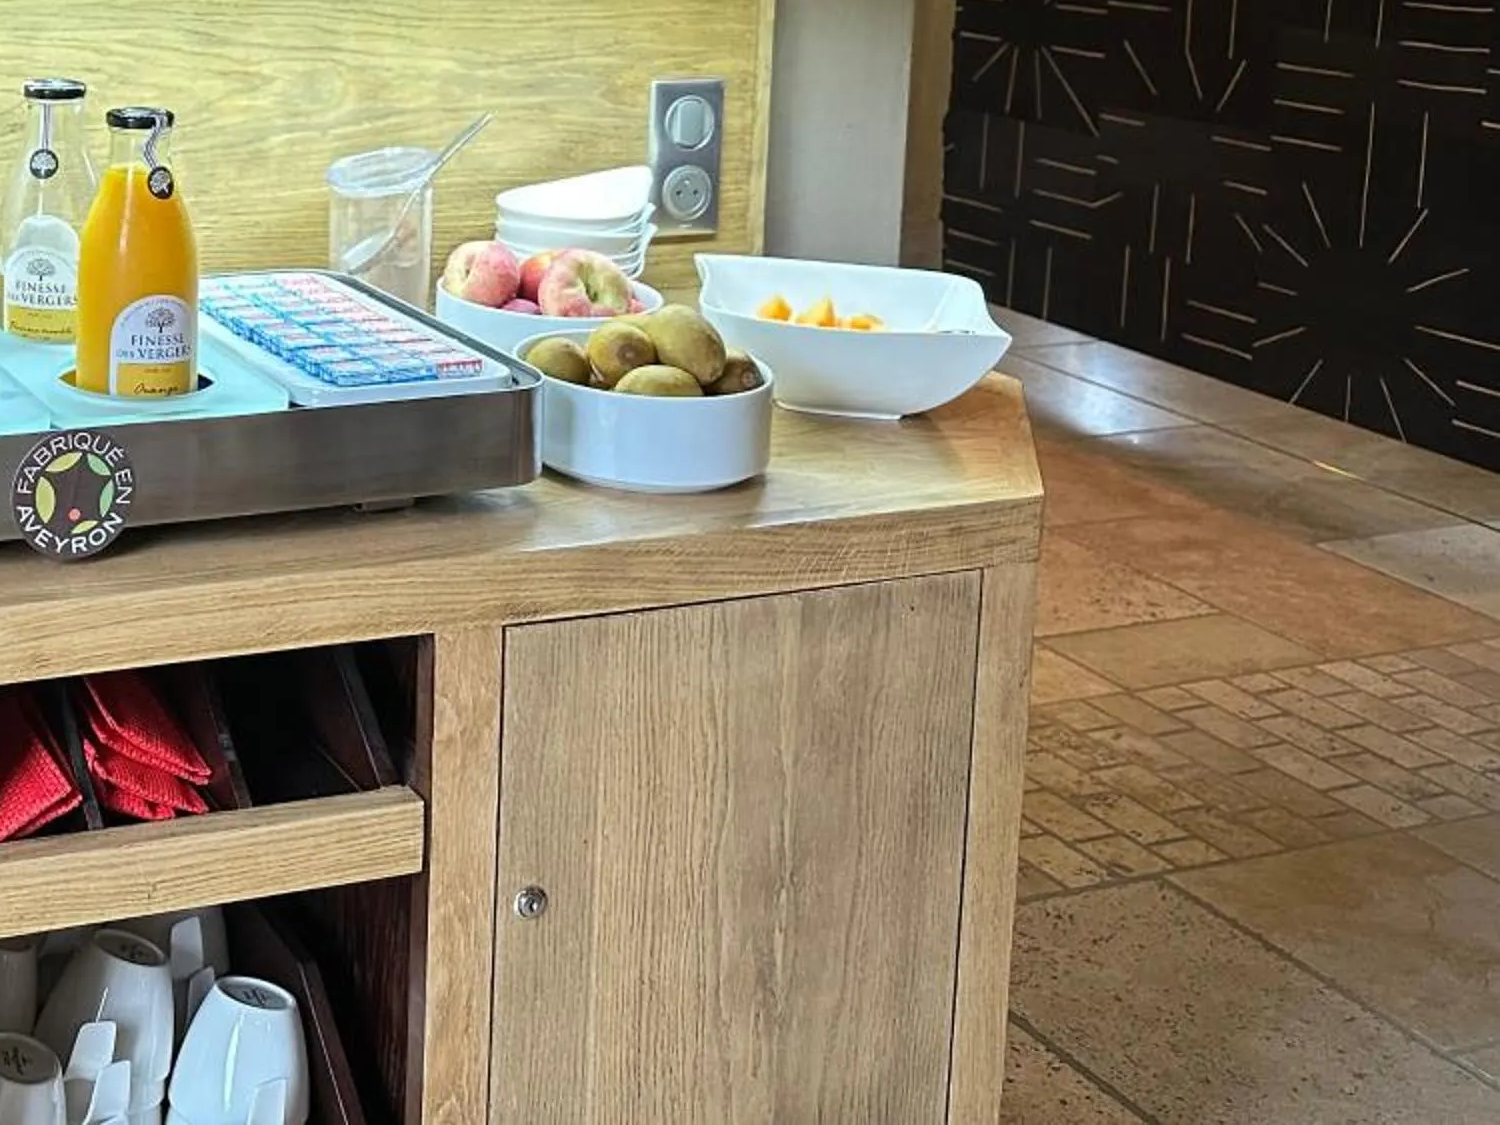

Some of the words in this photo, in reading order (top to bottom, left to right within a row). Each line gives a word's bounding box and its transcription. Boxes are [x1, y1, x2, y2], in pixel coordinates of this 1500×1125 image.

[15, 280, 67, 295] FINESSE
[130, 333, 185, 347] FINESSE
[16, 432, 125, 495] FABRIQUÉ
[114, 468, 134, 505] EN
[15, 505, 124, 554] AVEYRON
